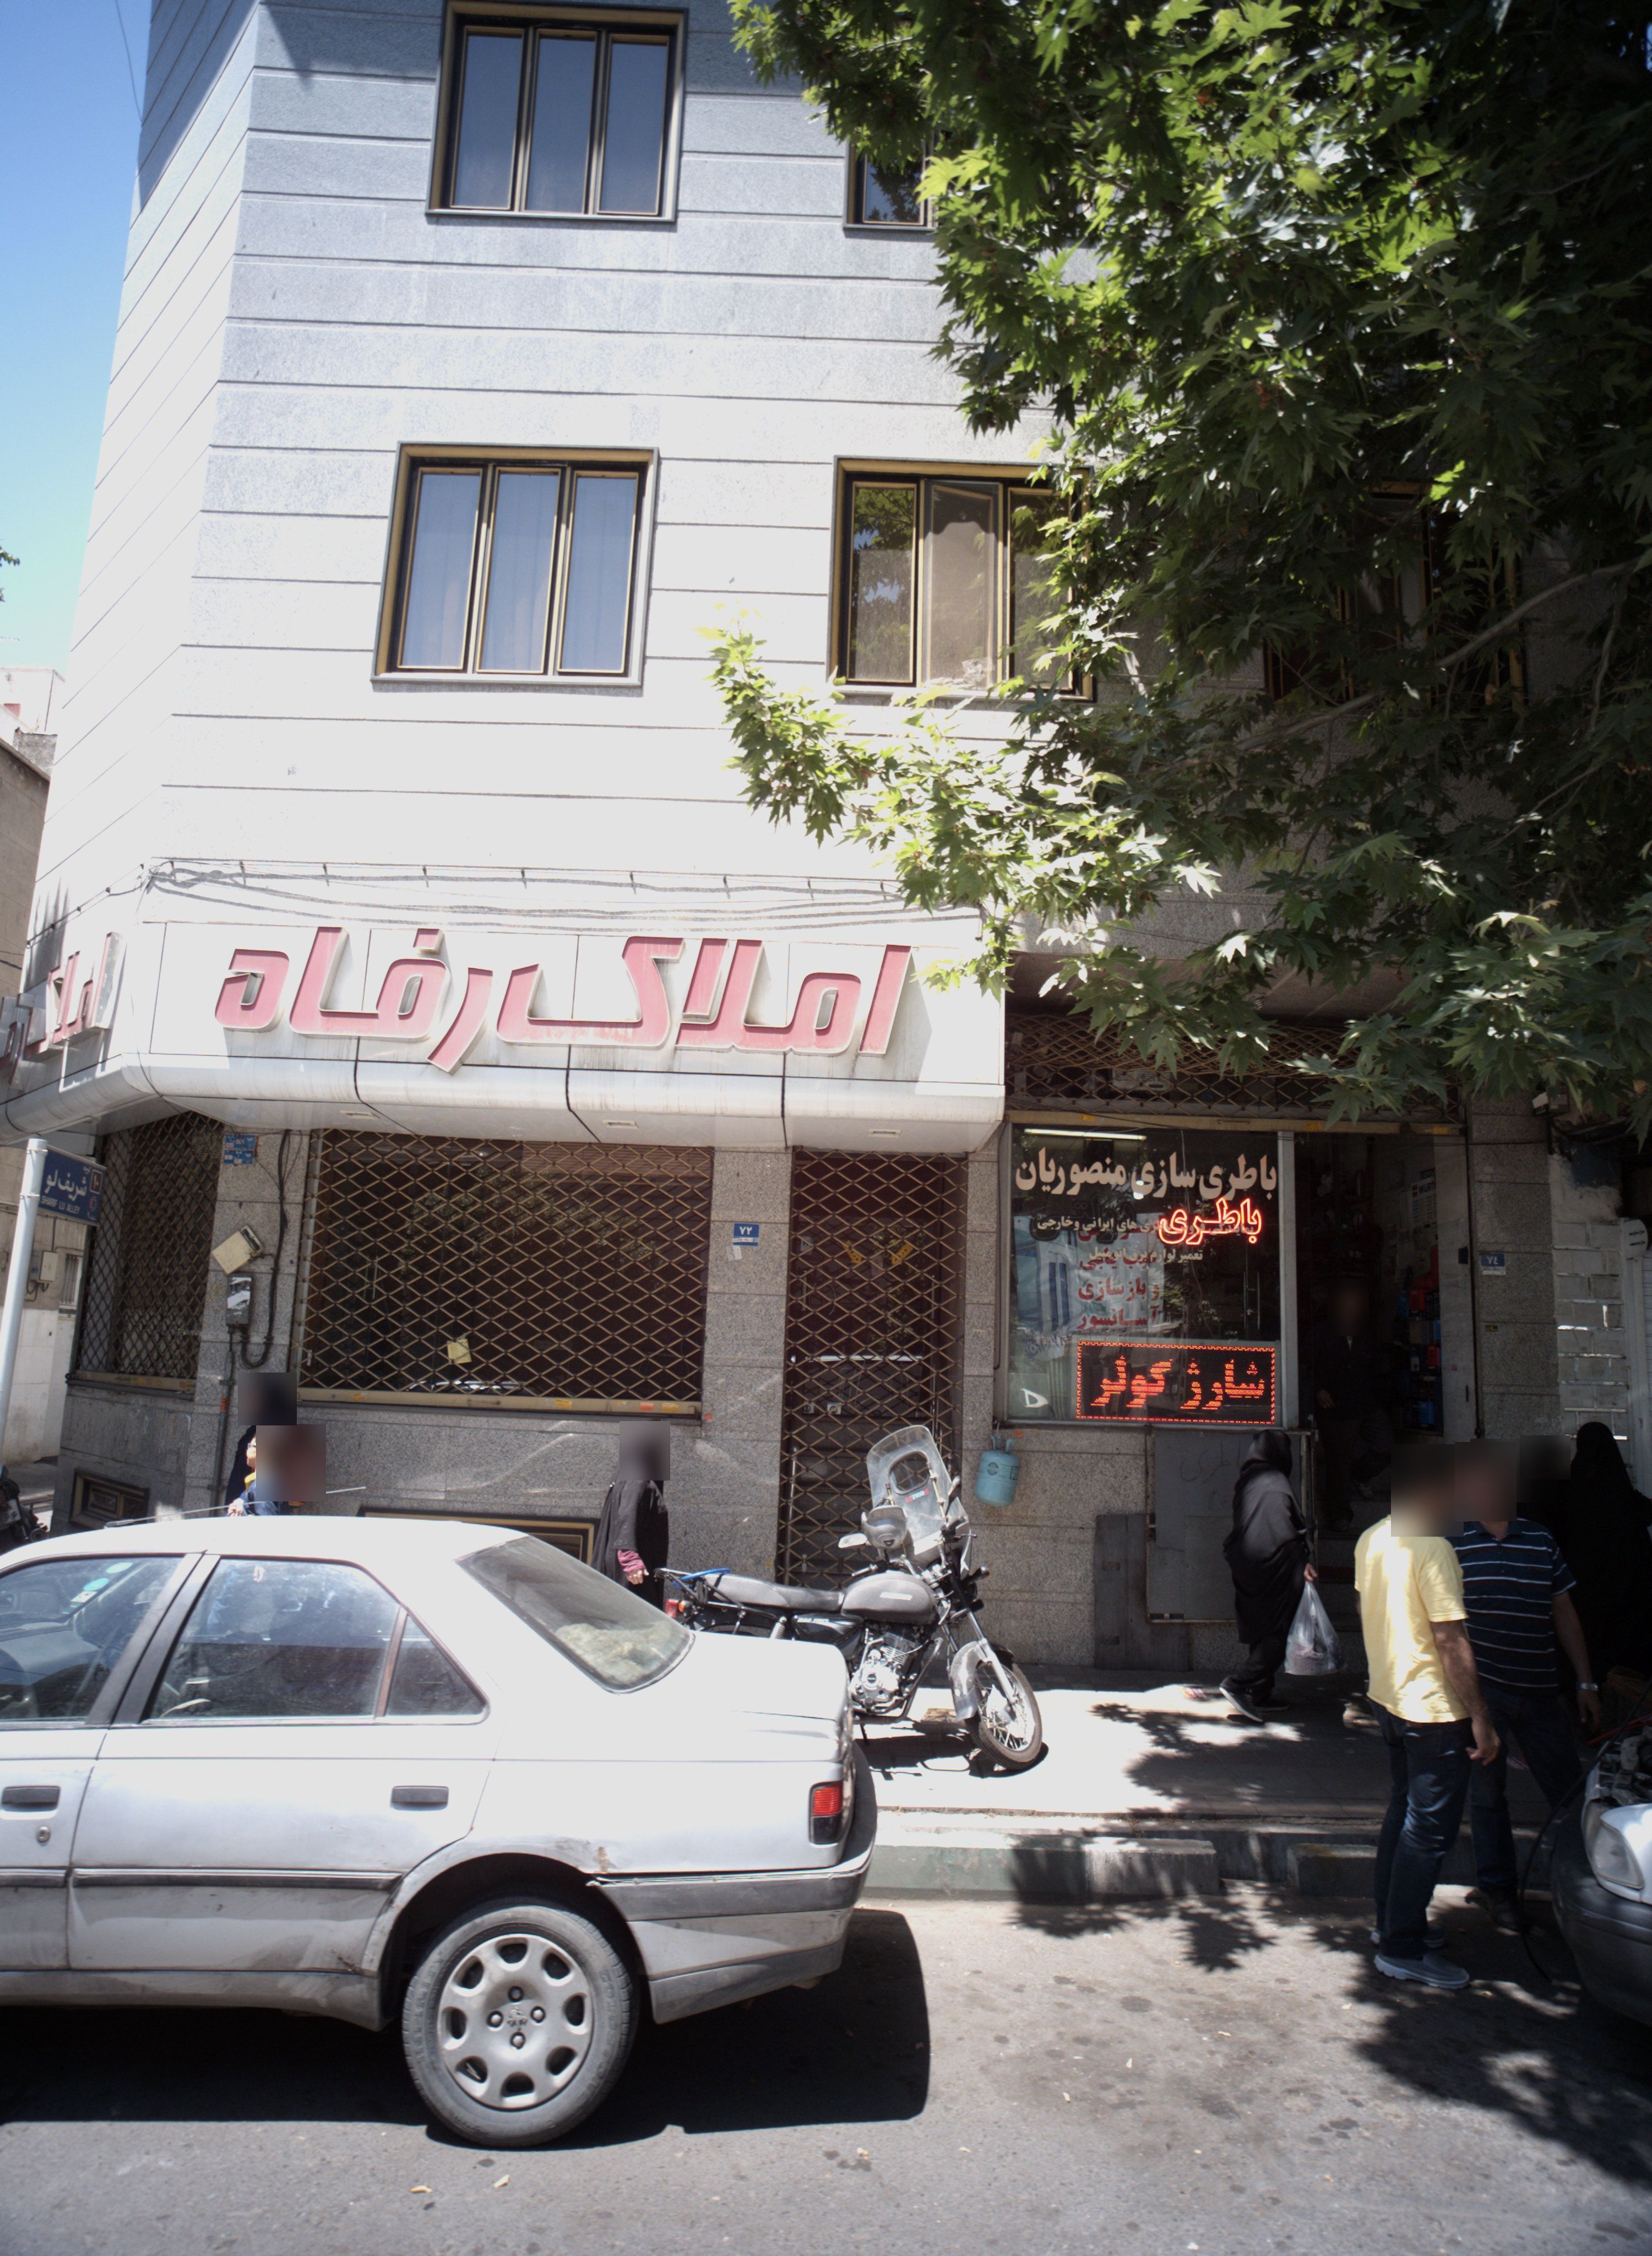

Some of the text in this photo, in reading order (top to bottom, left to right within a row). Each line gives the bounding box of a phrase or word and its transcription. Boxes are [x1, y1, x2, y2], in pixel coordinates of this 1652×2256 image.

[215, 926, 912, 1073] املاک رفاه
[1015, 1147, 1277, 1200] باطری سازی منصوریان
[67, 1203, 80, 1214] ALLEY
[1082, 1217, 1114, 1232] ایرانی
[1158, 1197, 1262, 1245] باطری
[739, 1226, 753, 1235] ۷۲
[1150, 1248, 1176, 1263] لوازم
[1177, 1249, 1203, 1263] تعمیر
[1090, 1355, 1265, 1411] شارژ کولر
